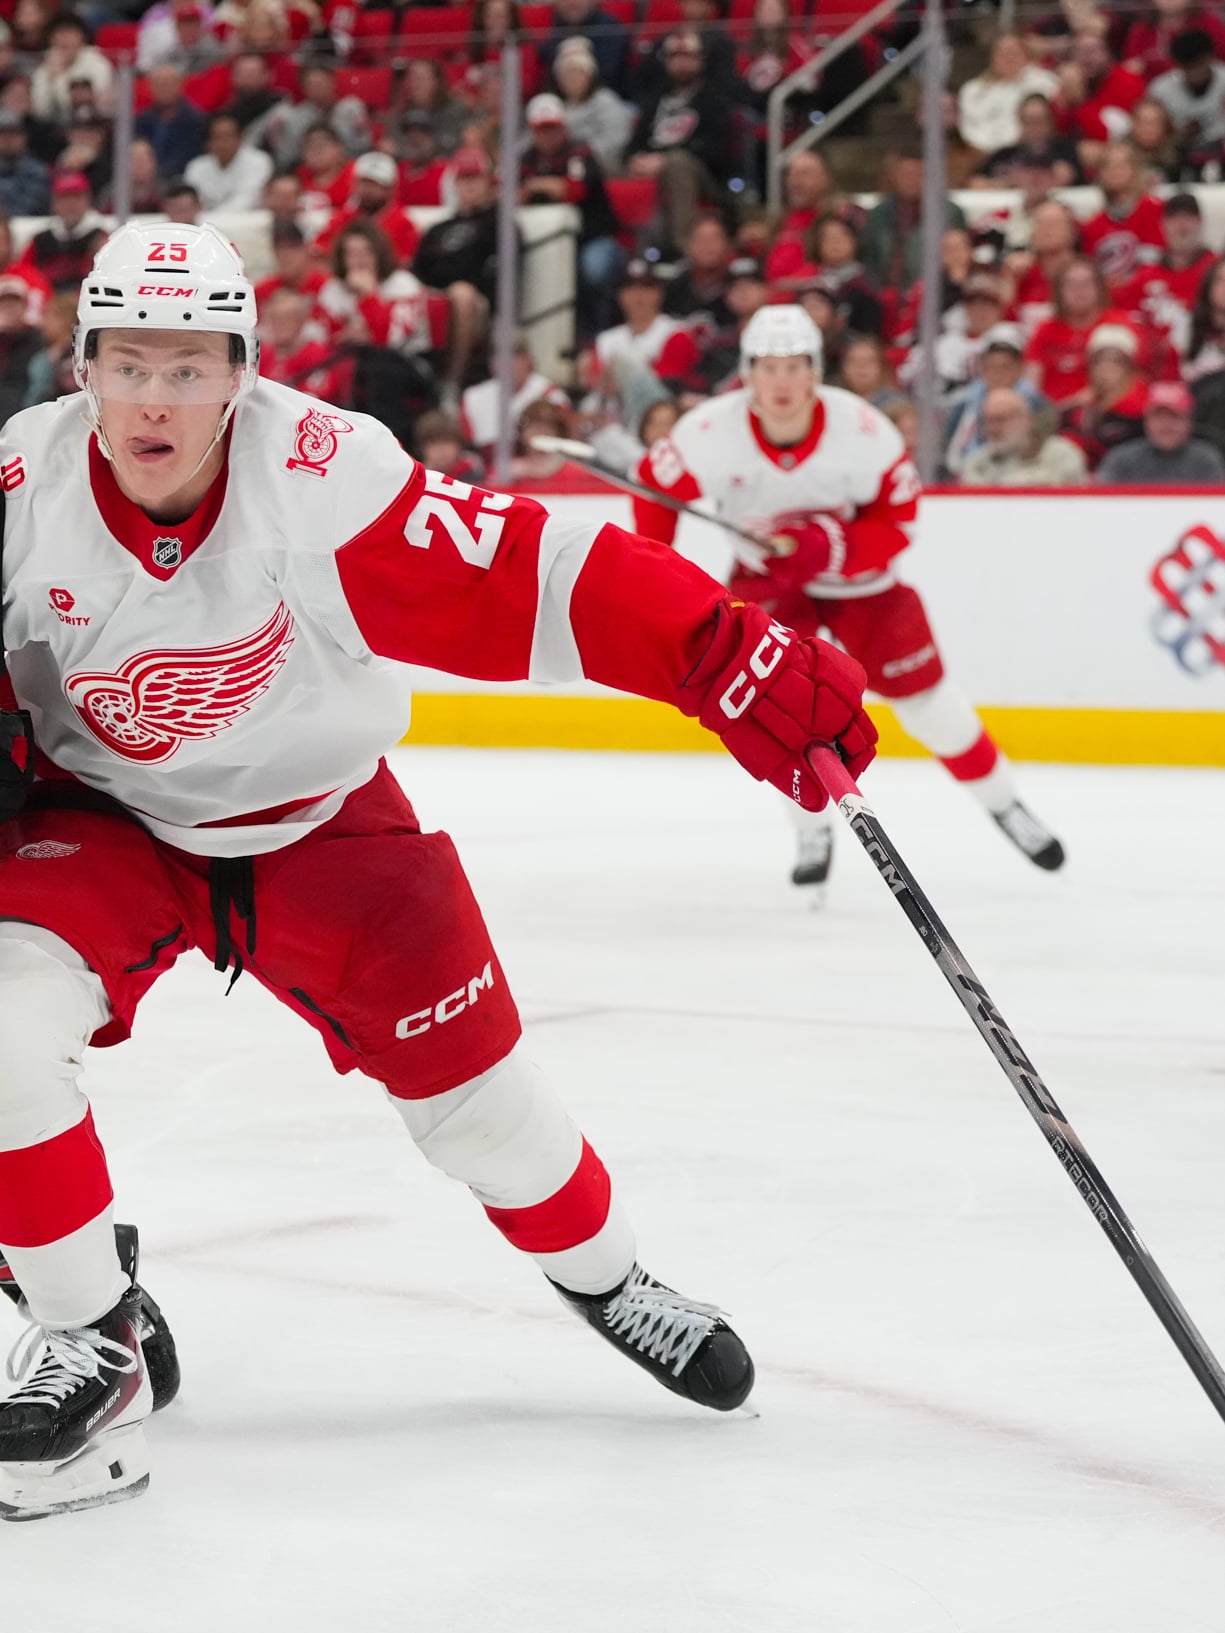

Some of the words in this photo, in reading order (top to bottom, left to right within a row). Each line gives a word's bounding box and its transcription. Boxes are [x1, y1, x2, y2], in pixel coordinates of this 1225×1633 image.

[147, 242, 188, 262] 25
[137, 286, 194, 298] CCM
[1, 456, 26, 492] 10
[403, 469, 515, 570] 25
[158, 544, 176, 562] NHL
[719, 618, 796, 720] CCM
[850, 817, 907, 896] CCM
[395, 961, 494, 1040] CCM
[86, 1388, 121, 1432] BAUER
